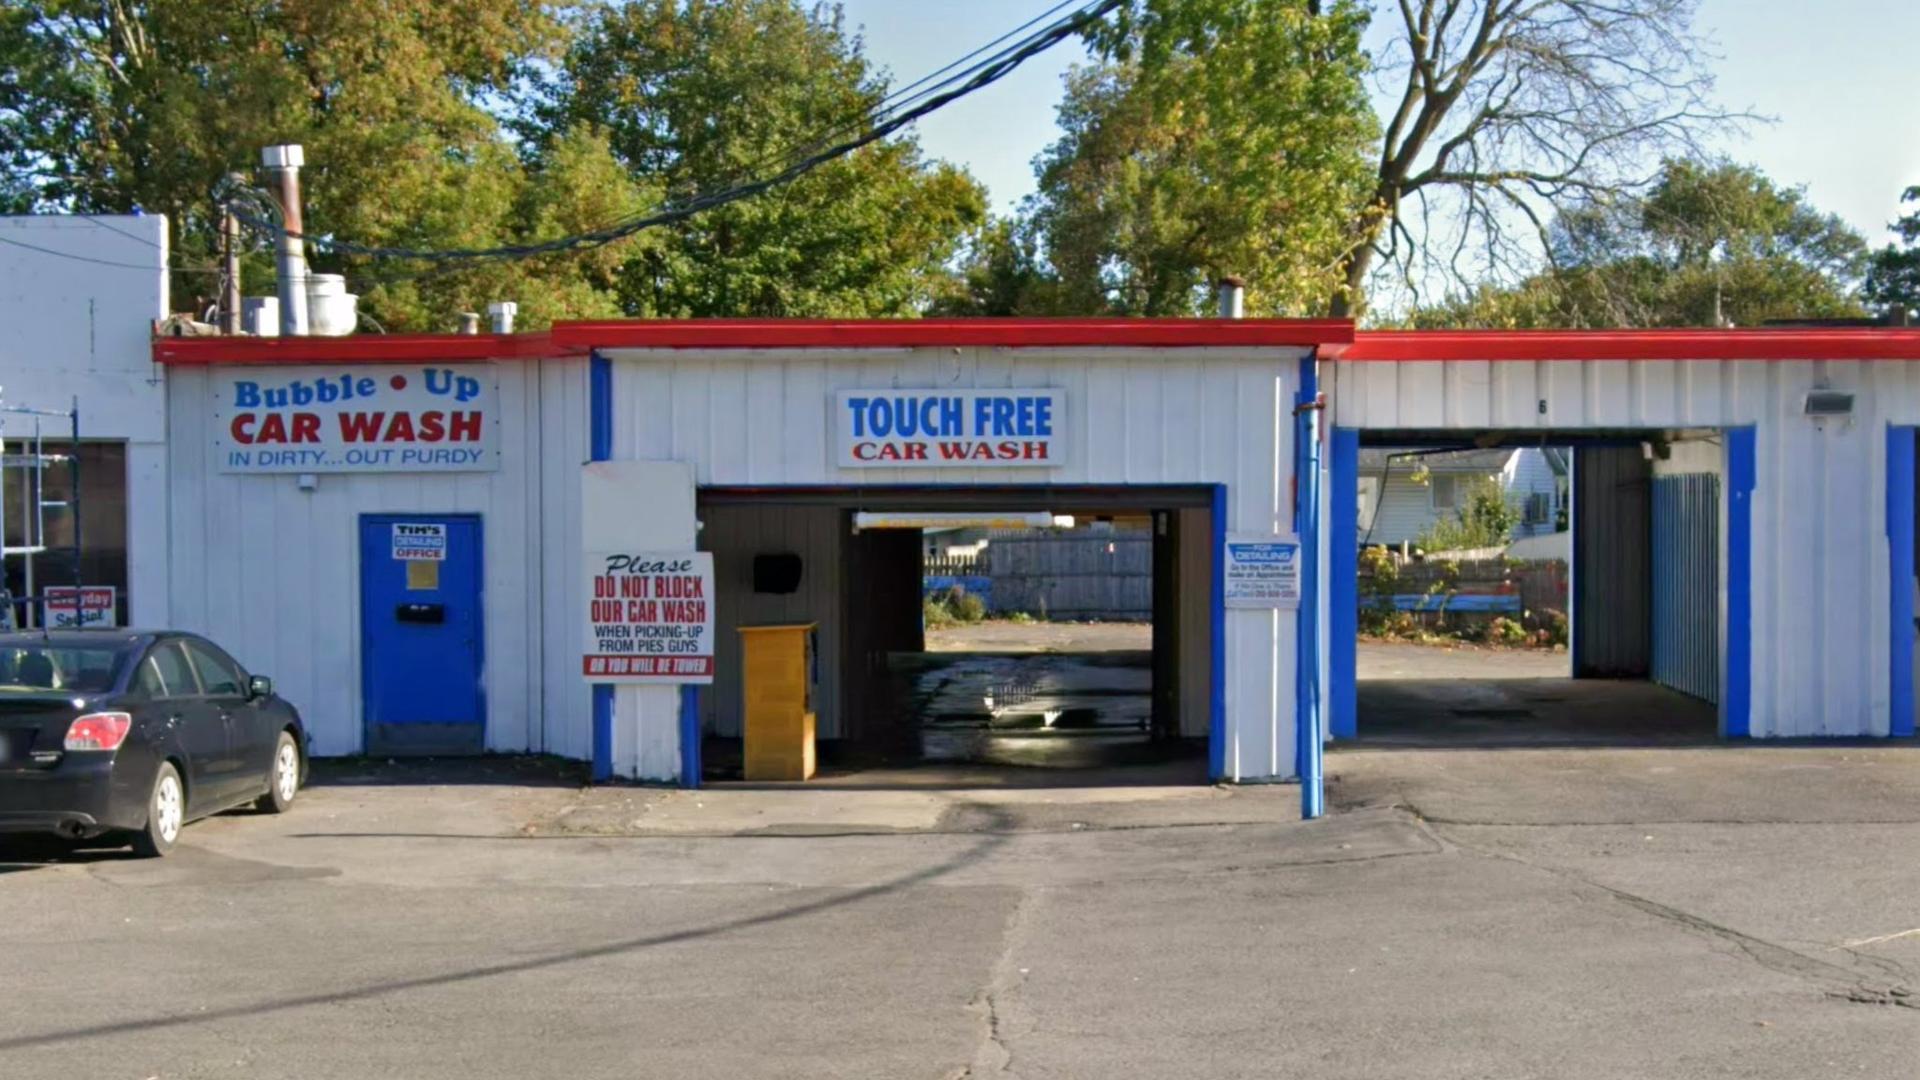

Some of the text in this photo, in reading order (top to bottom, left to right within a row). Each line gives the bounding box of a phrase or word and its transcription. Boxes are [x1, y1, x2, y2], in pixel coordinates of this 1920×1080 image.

[234, 368, 480, 408] Bubble Up
[848, 397, 1053, 437] TOUCH FREE
[230, 410, 483, 445] CAR WASH
[228, 451, 250, 466] IN
[401, 448, 483, 465] PURDY
[853, 441, 1048, 460] CAR WASH
[397, 525, 441, 534] TIM'S
[396, 548, 442, 558] OFFICE
[1235, 552, 1290, 560] DETAILING
[606, 554, 693, 575] Please
[594, 576, 703, 598] DO NOT BLOCK
[591, 601, 705, 623] OUR CAR WASH
[594, 625, 703, 638] WHEN PICKING-UP
[598, 640, 698, 652] FROM PIES GUYS
[608, 658, 628, 673] YOU
[631, 658, 654, 673] WILL
